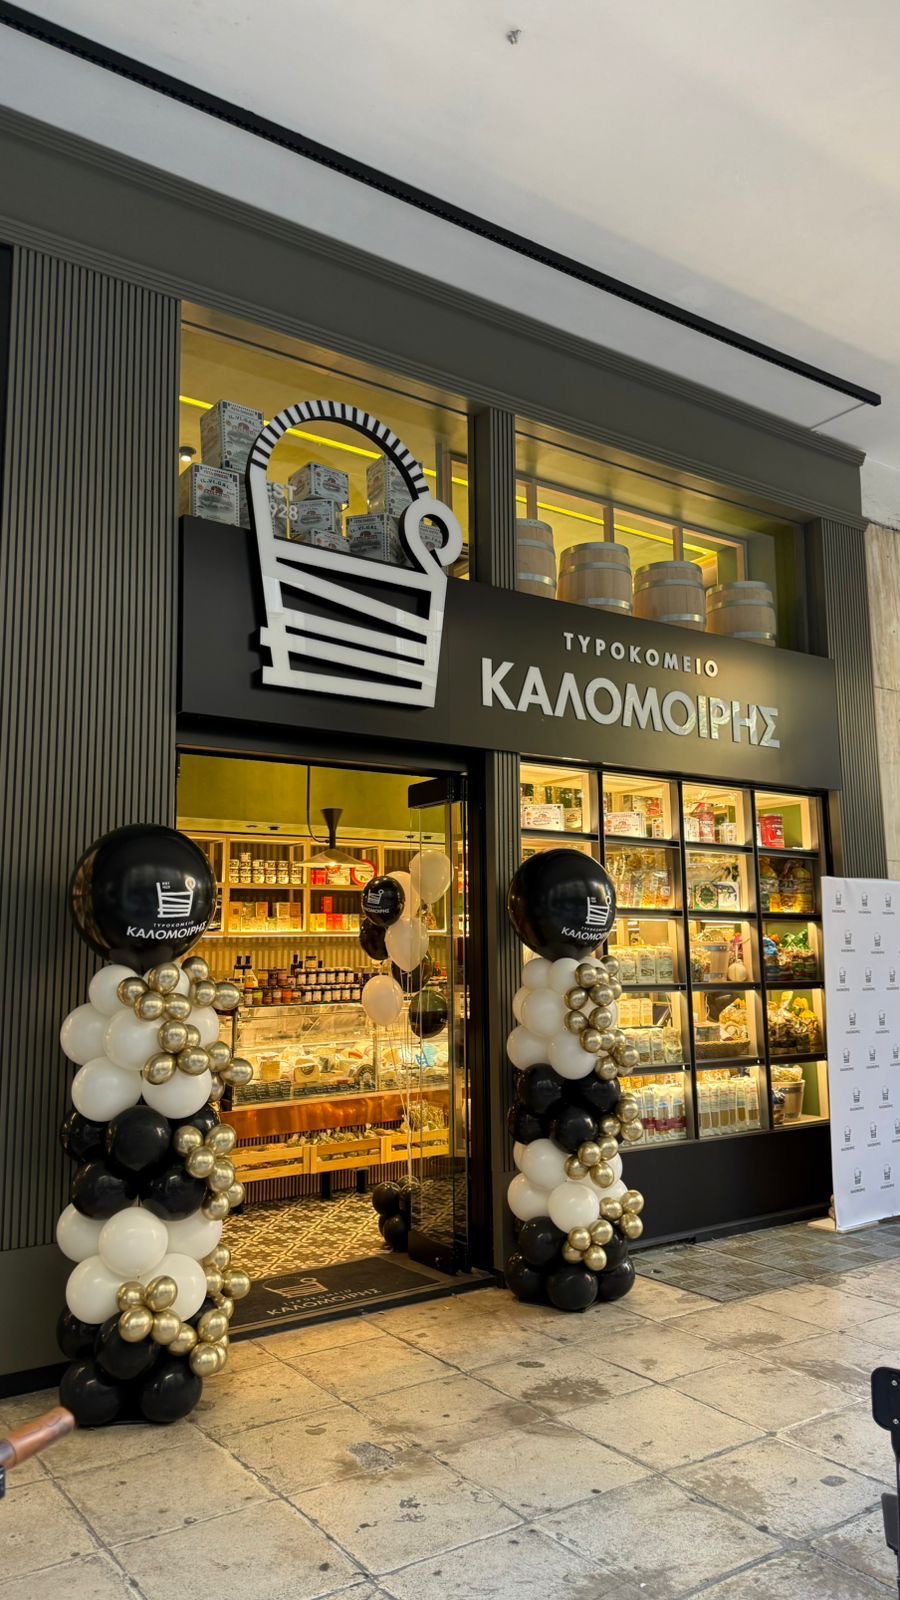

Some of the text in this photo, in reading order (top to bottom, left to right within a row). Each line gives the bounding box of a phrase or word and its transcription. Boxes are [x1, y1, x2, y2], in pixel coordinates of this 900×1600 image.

[269, 502, 299, 521] 928
[563, 631, 719, 678] ΤΥΡΟΚΟΜΕΙΟ
[481, 657, 781, 749] ΚΑΛΟΜΟΙΡΗΣ
[126, 920, 208, 940] ΚΑΛΟΜΟΙΡΗΣ
[266, 1288, 382, 1316] ΚΑΛΟΜΟΙΡΗΣ
